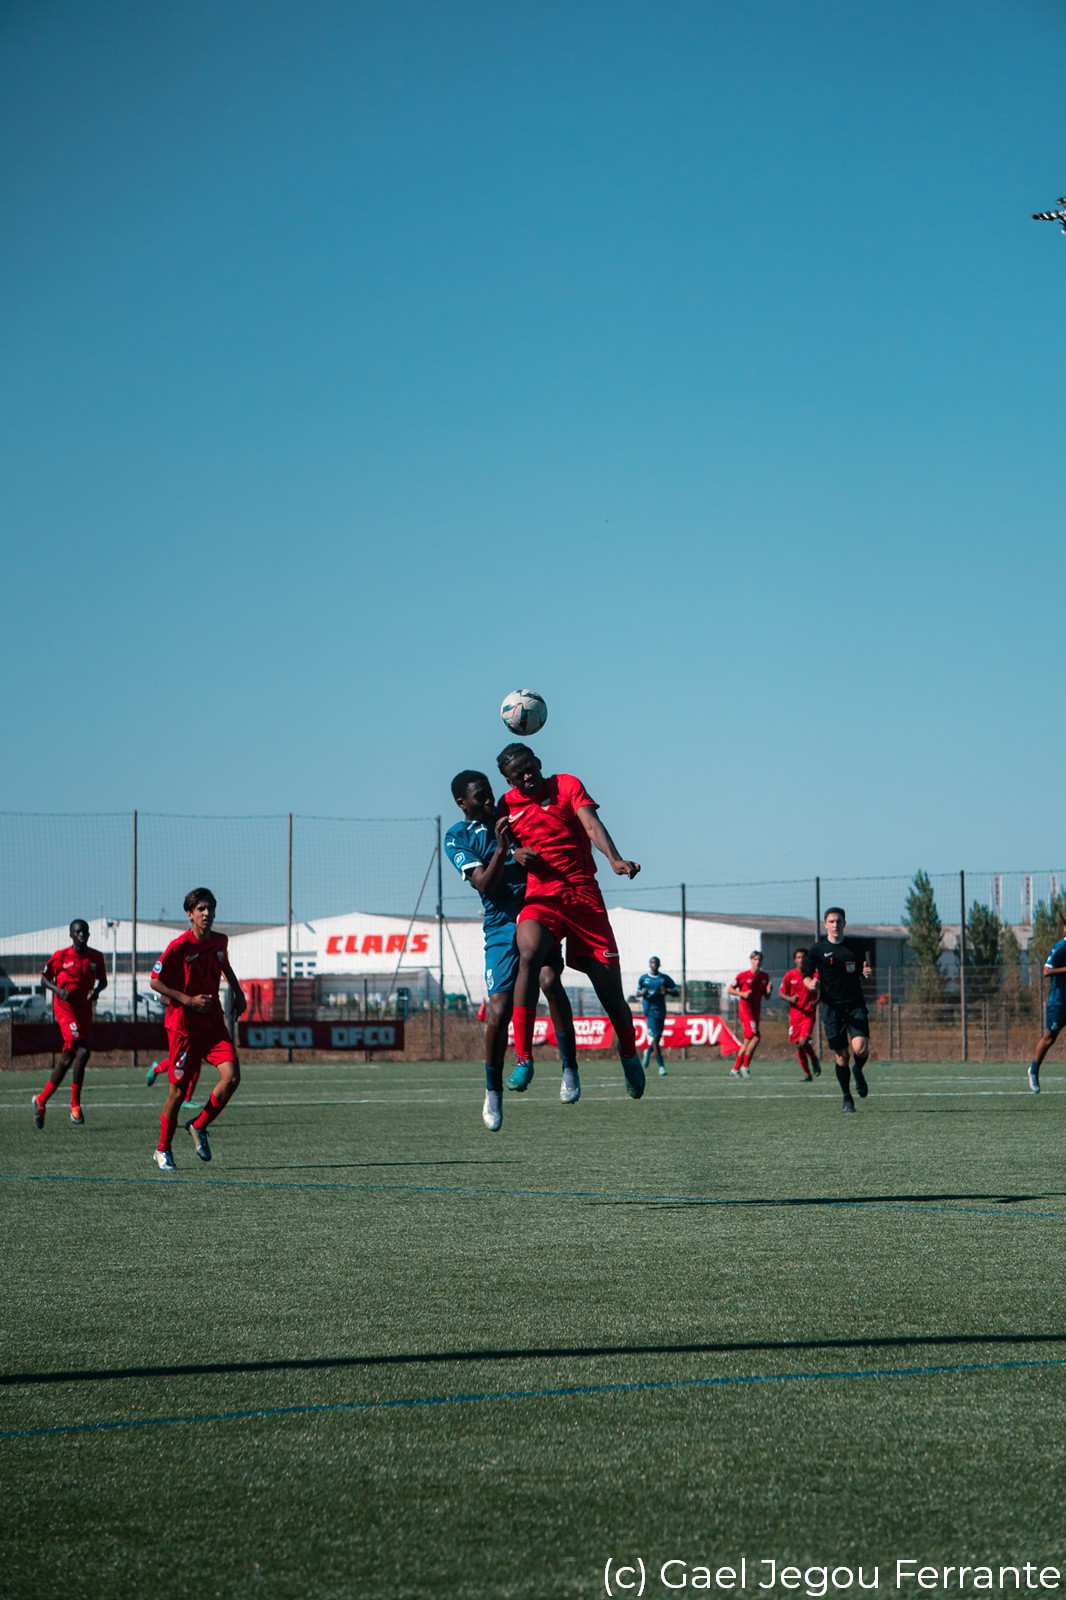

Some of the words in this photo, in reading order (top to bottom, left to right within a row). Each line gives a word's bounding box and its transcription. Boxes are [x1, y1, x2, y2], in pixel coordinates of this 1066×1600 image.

[326, 934, 429, 955] CLAAS
[247, 1026, 313, 1047] DFCO
[331, 1026, 396, 1047] DFCO
